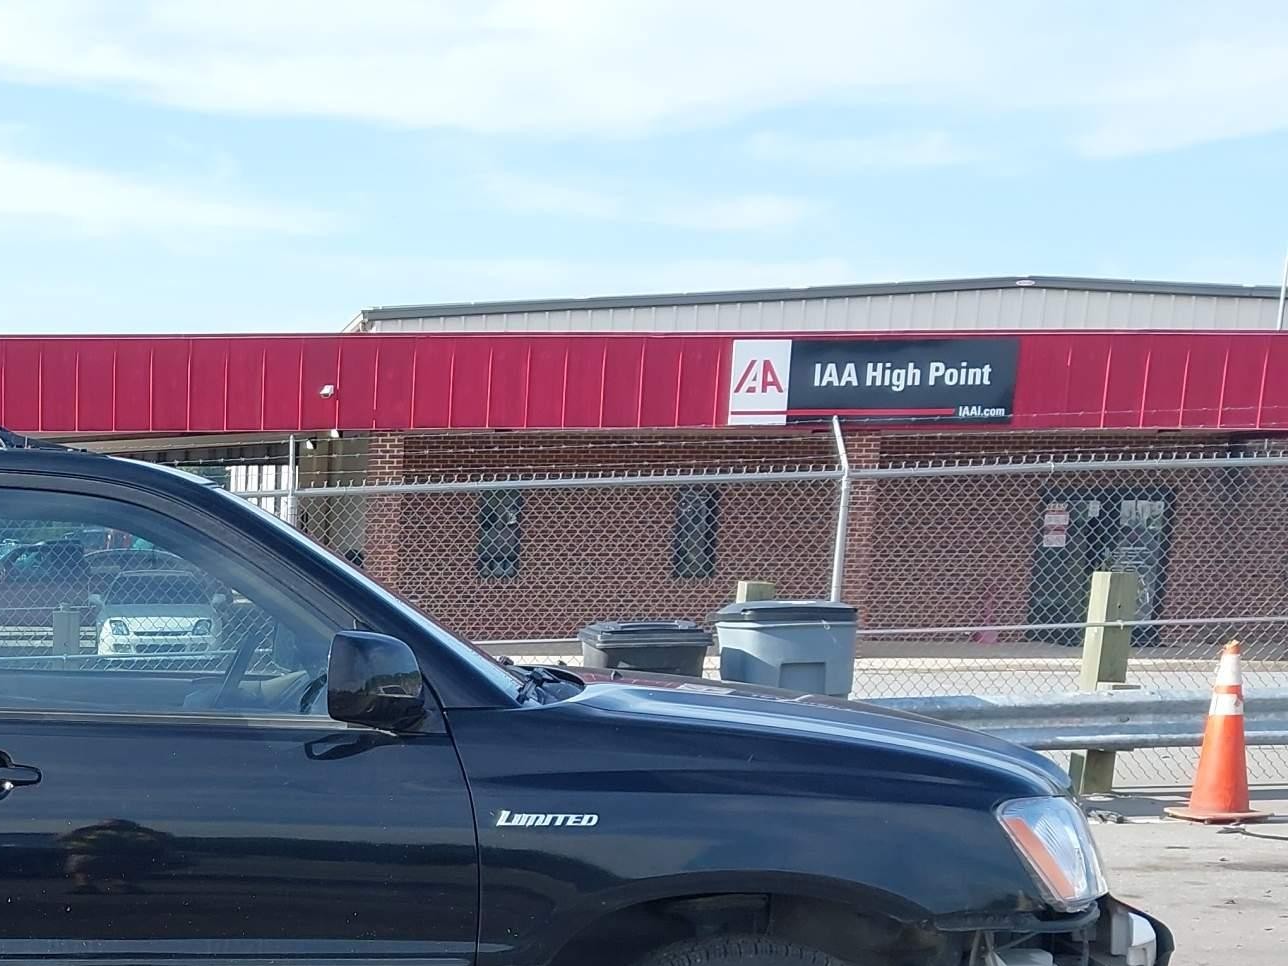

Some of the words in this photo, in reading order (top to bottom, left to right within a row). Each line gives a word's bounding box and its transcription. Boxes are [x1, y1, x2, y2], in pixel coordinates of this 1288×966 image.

[813, 363, 859, 388] IAA
[865, 363, 921, 393] High
[928, 361, 992, 387] Point
[958, 405, 1006, 417] IAAI.com
